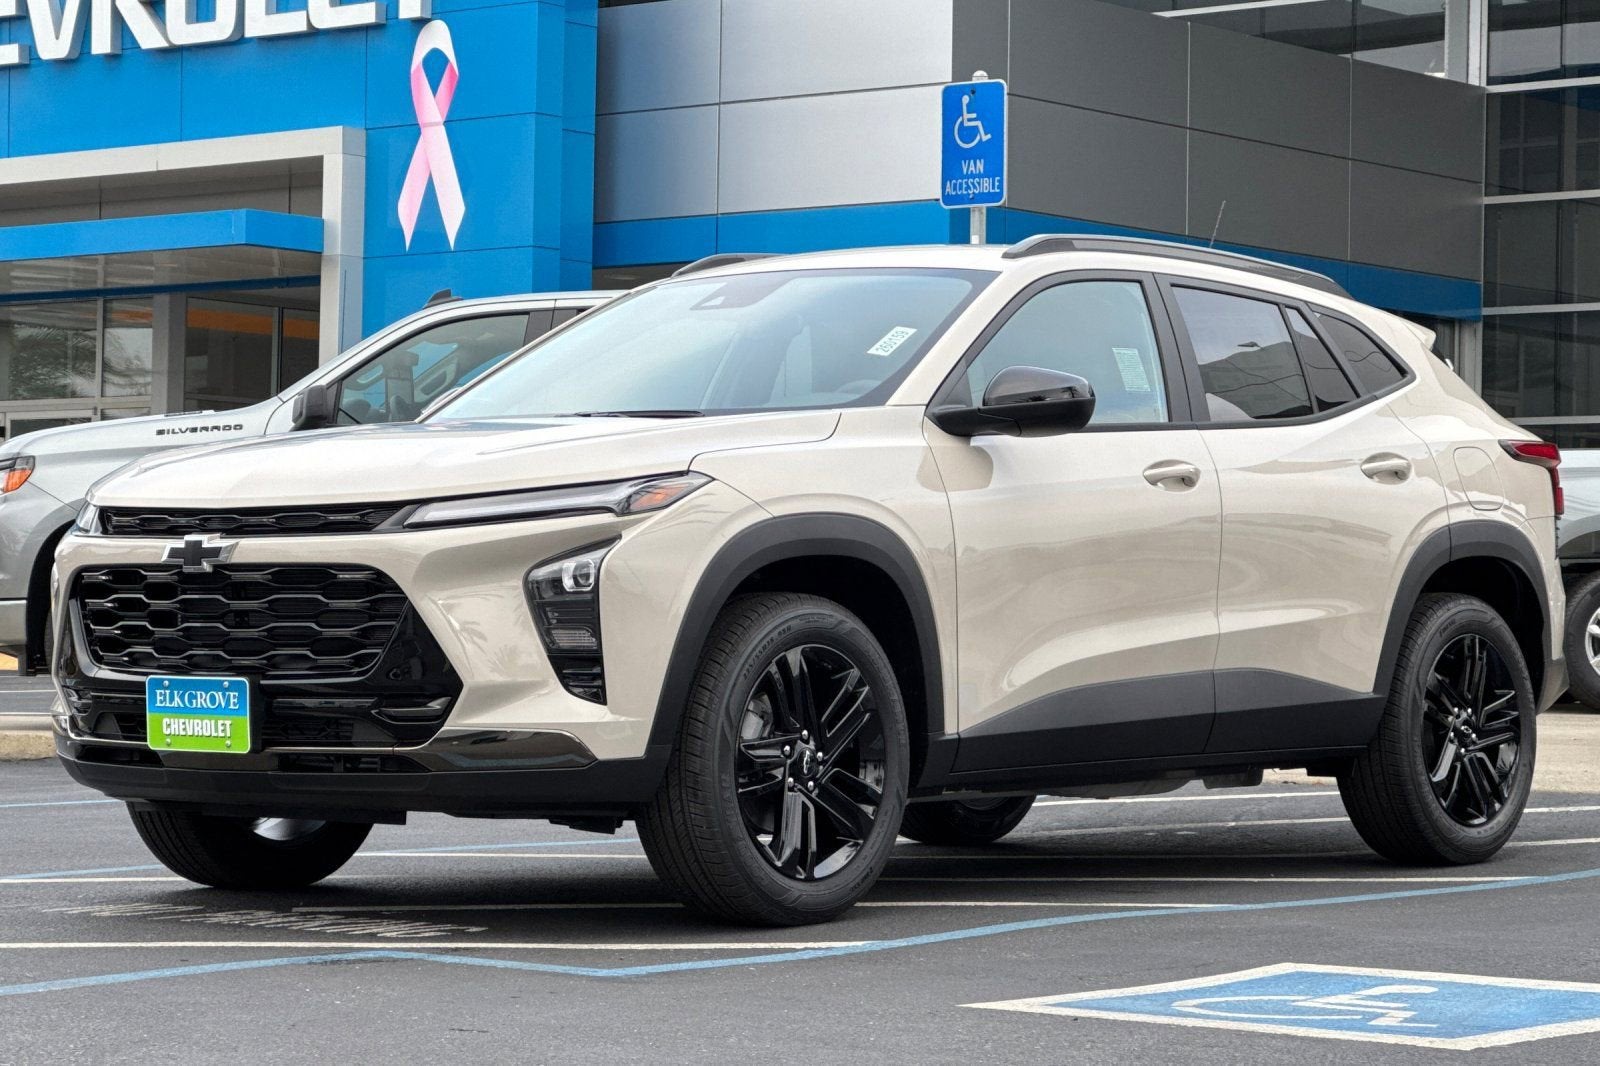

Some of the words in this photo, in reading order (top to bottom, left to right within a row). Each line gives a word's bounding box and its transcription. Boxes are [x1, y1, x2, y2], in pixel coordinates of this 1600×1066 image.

[961, 159, 984, 175] VAN
[945, 177, 1000, 195] ACCESSIBLE
[156, 424, 243, 436] SILVERADO
[155, 689, 184, 708] ELK
[184, 690, 239, 709] GROVE
[162, 718, 232, 737] CHEVROLET
